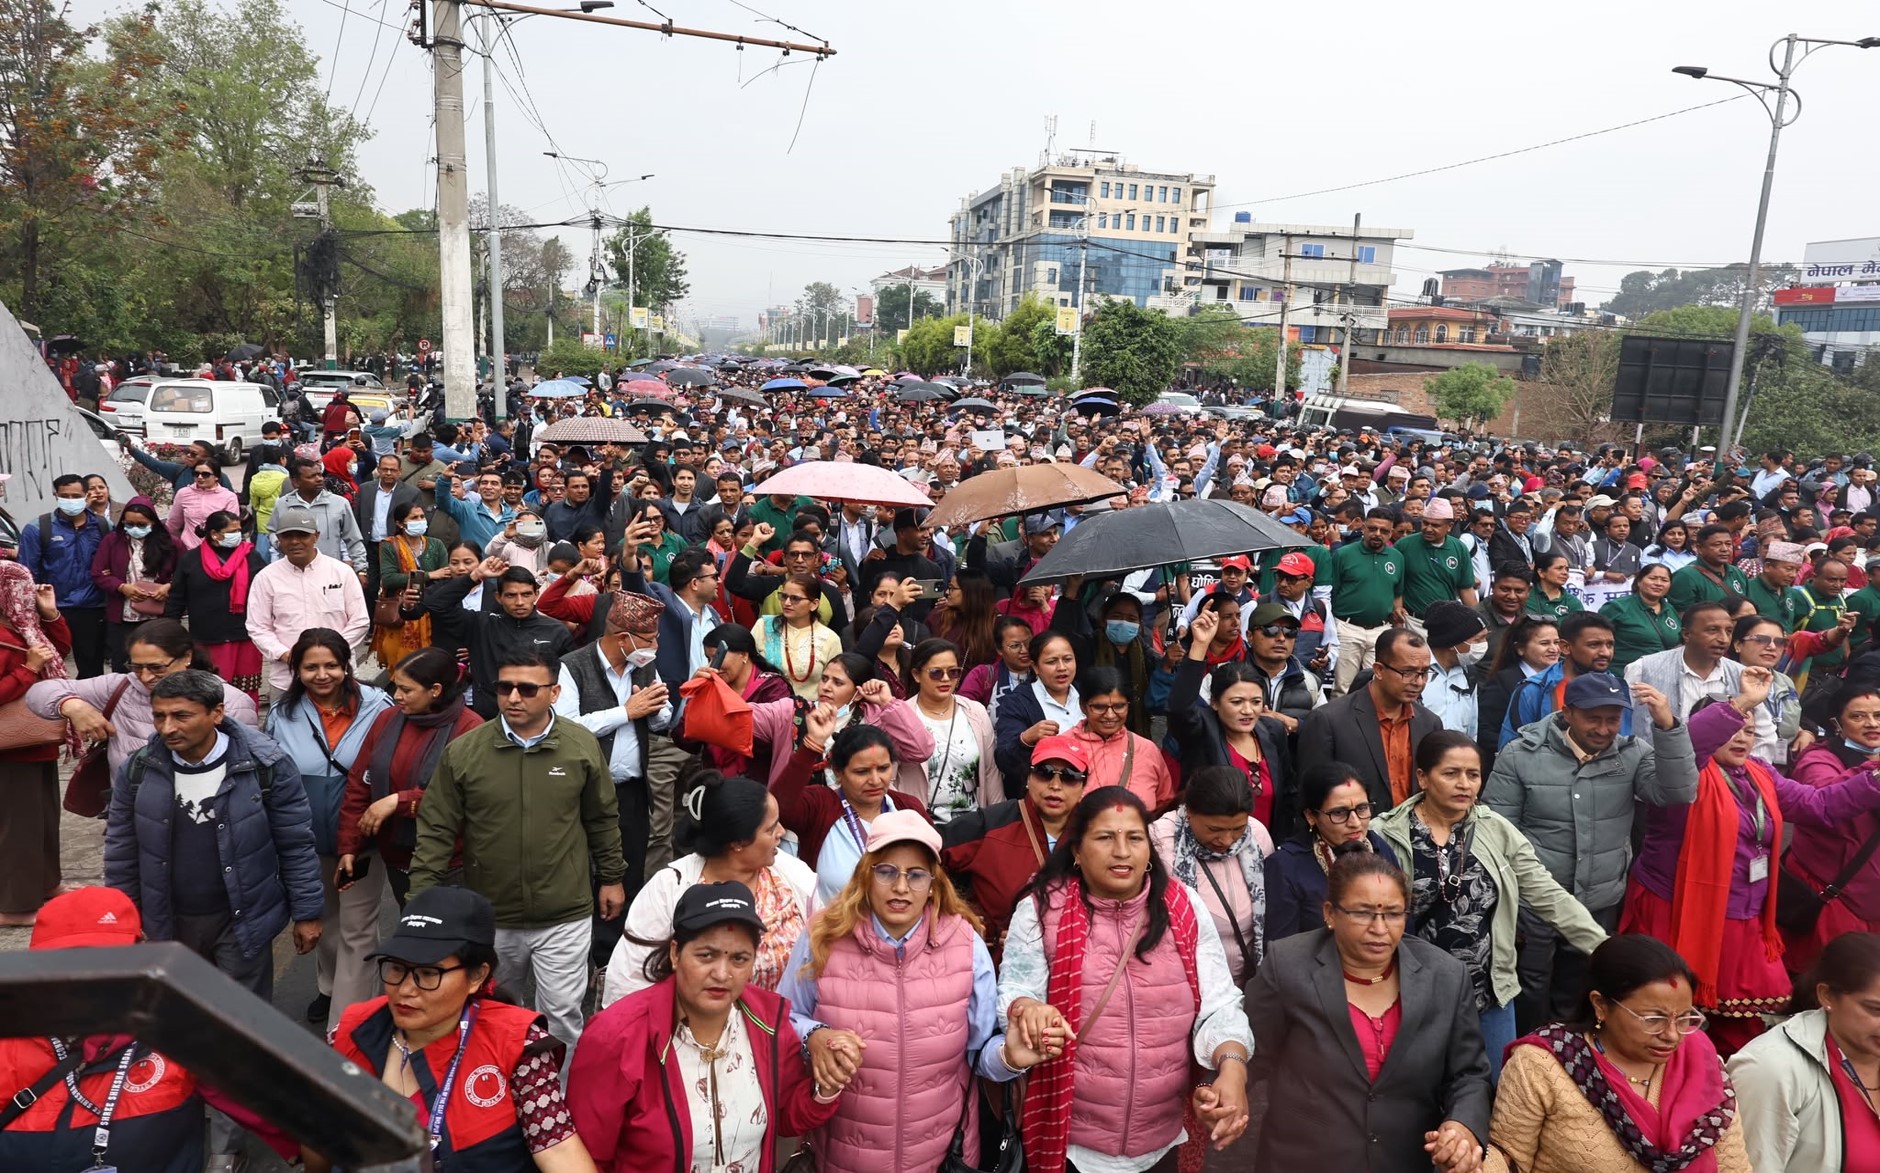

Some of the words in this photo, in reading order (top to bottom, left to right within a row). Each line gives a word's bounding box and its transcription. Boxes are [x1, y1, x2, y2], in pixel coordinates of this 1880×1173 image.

[1808, 265, 1854, 276] नेपाल
[70, 1085, 93, 1109] SHIKSHA
[100, 1104, 115, 1126] SHREE
[108, 1071, 125, 1101] SHIKSHA
[119, 1048, 133, 1068] SADAN
